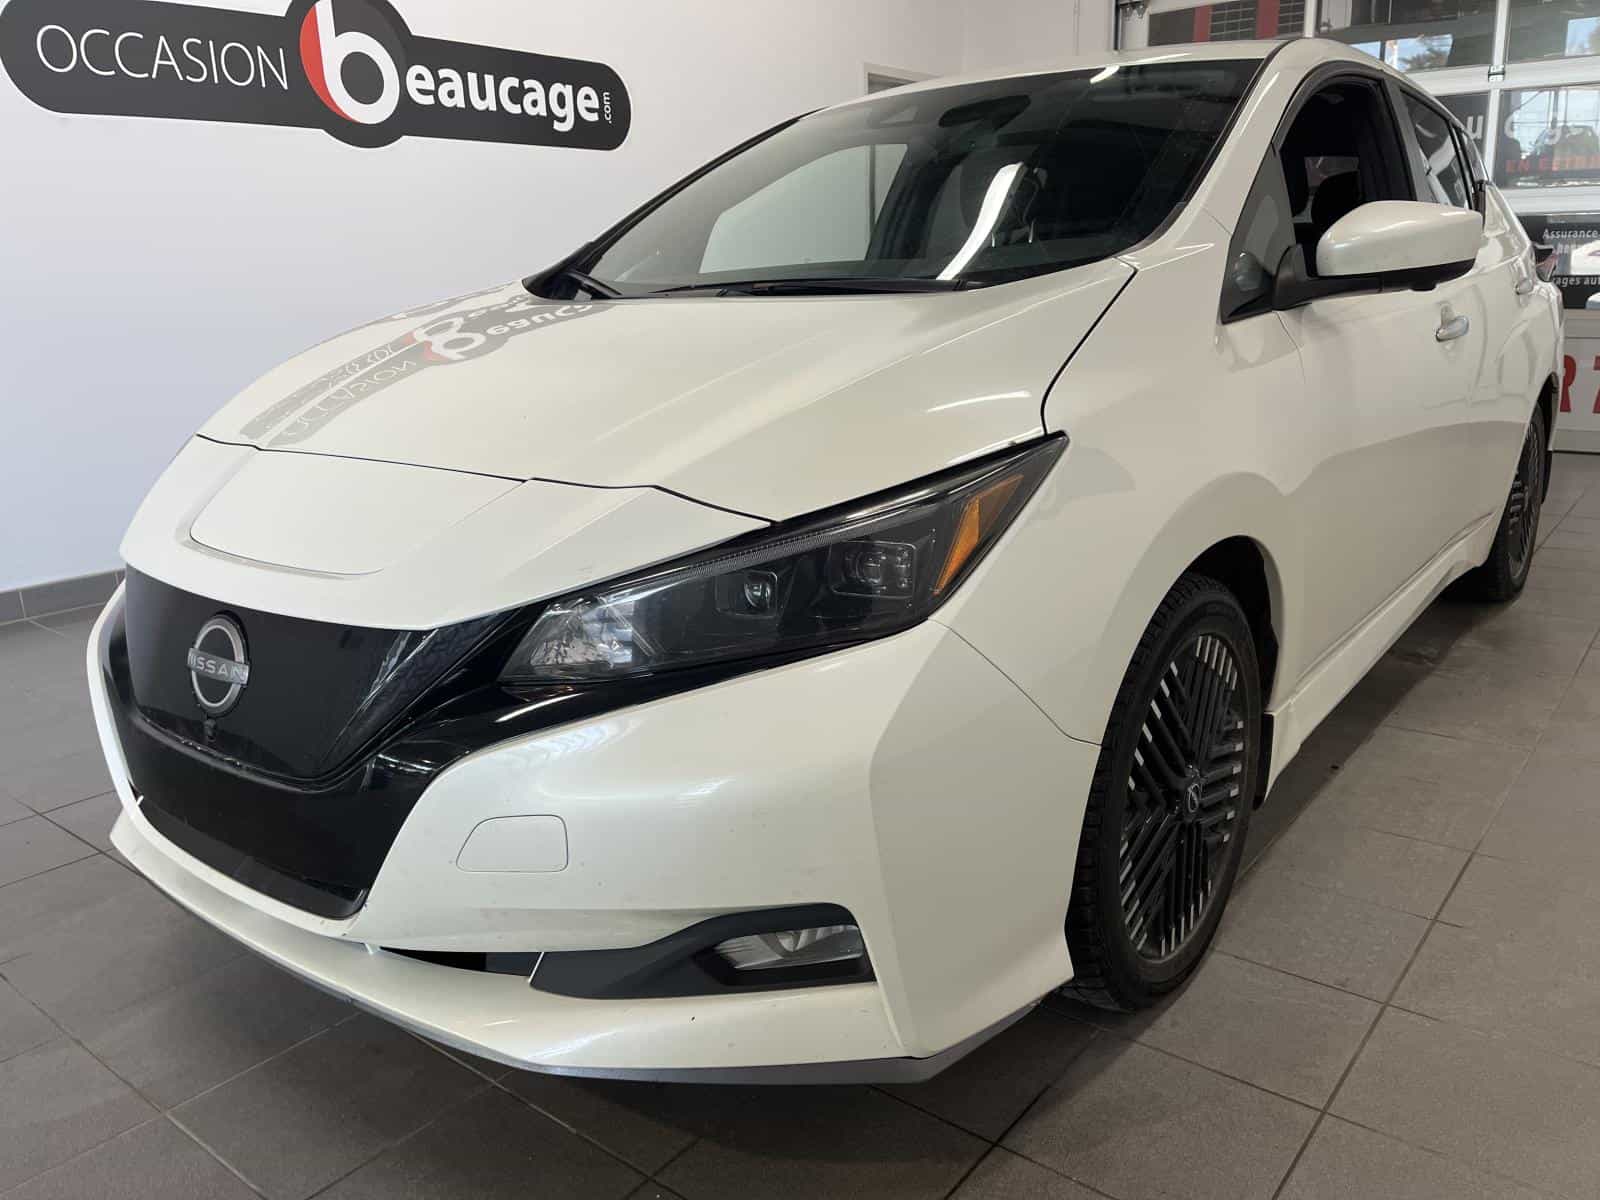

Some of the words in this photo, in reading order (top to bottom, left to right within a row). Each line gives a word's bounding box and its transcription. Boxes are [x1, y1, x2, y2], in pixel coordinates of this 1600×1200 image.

[36, 24, 289, 91] OCCASION
[601, 91, 611, 124] .com
[189, 654, 247, 682] NISSAN
